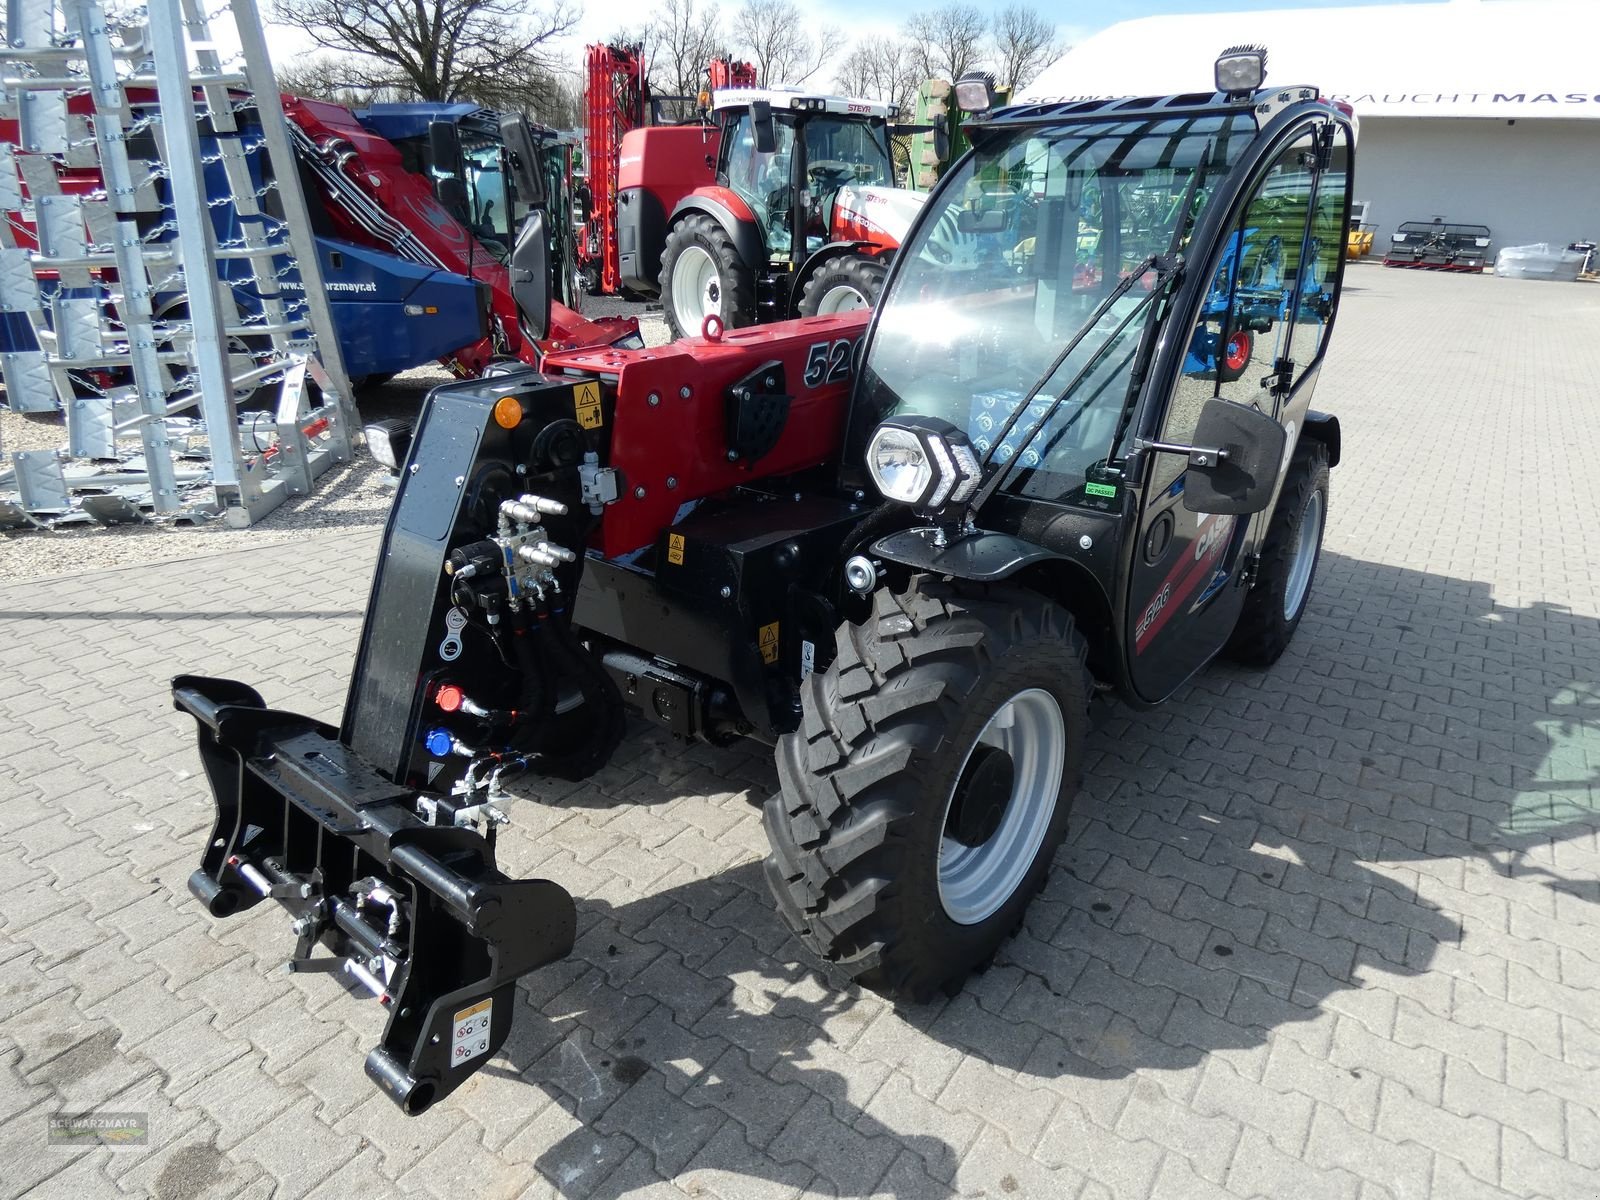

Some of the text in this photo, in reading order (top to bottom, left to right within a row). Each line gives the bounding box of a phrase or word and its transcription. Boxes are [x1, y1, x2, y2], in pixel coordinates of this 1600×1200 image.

[1320, 93, 1600, 104] RAUCHTMAS
[847, 104, 872, 113] STEYR
[279, 282, 377, 293] ww.srzmayr.at
[1143, 583, 1171, 631] 526
